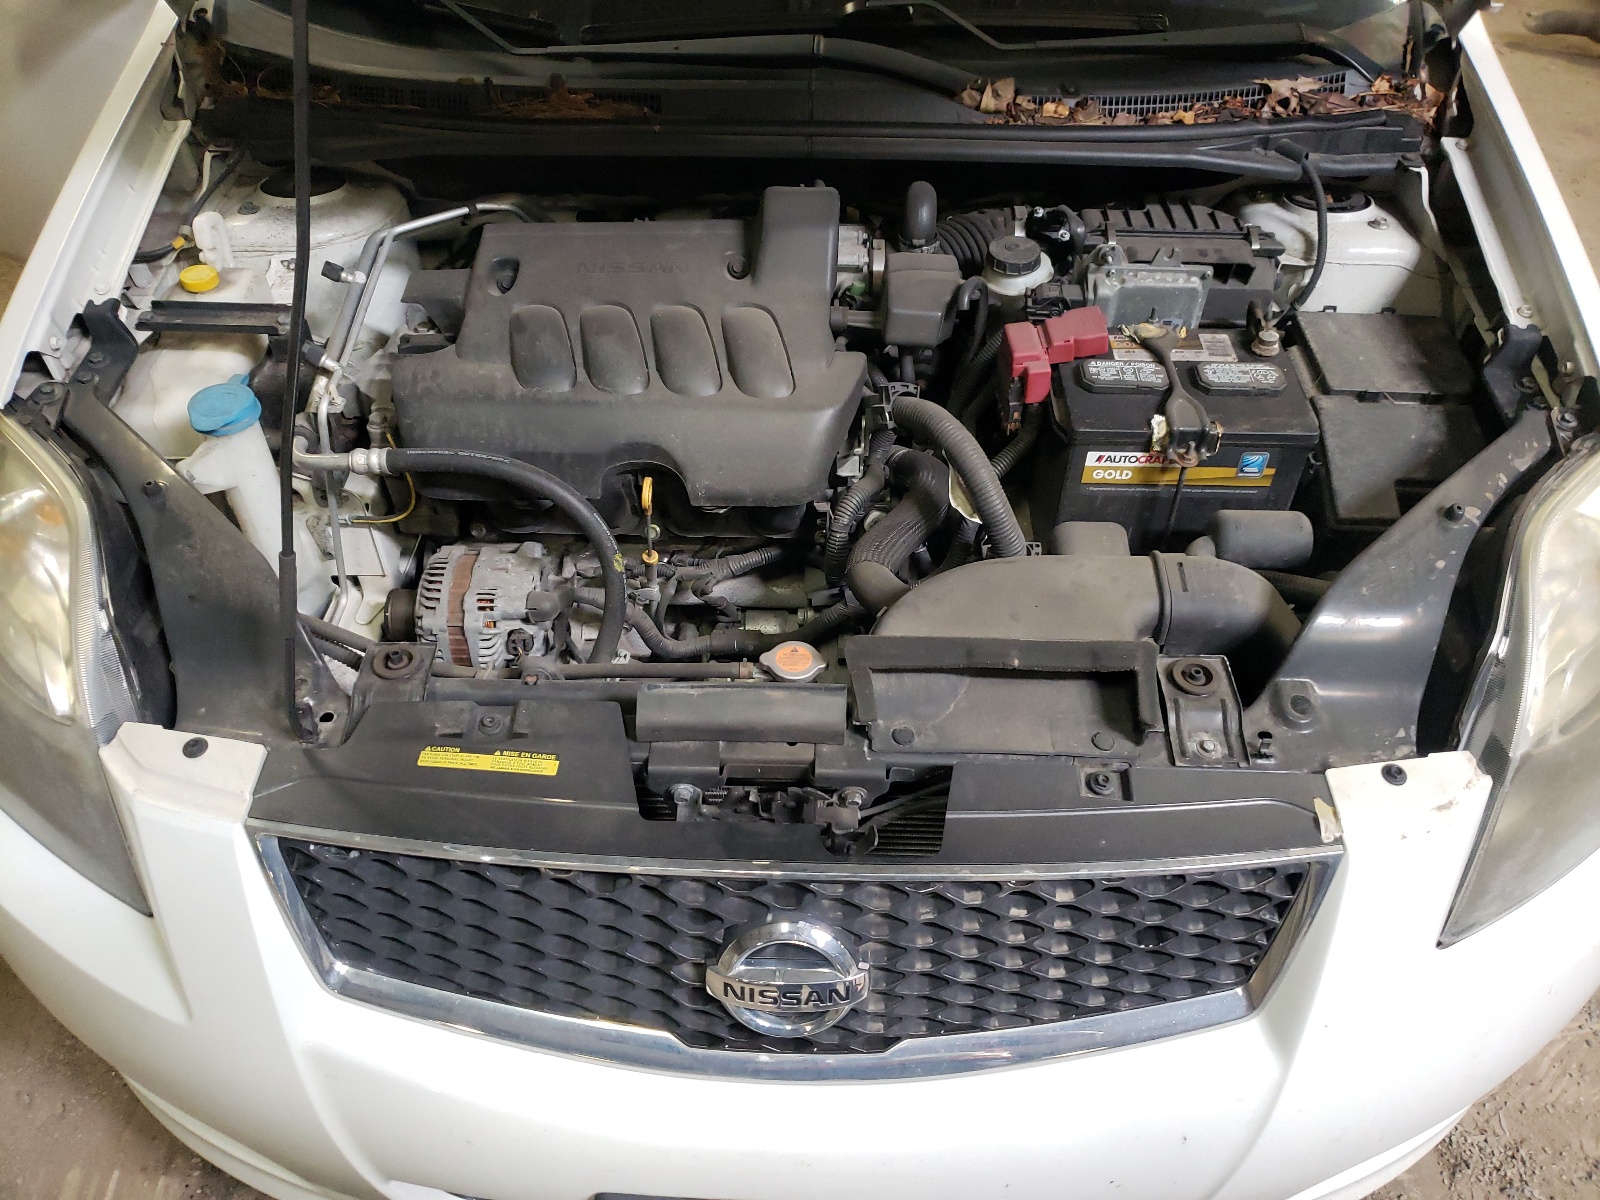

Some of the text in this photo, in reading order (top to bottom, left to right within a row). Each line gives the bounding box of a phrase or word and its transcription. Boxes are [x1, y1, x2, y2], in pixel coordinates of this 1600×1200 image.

[1092, 469, 1133, 480] GOLD
[531, 752, 557, 760] GARDE
[723, 981, 851, 1007] NISSAN
